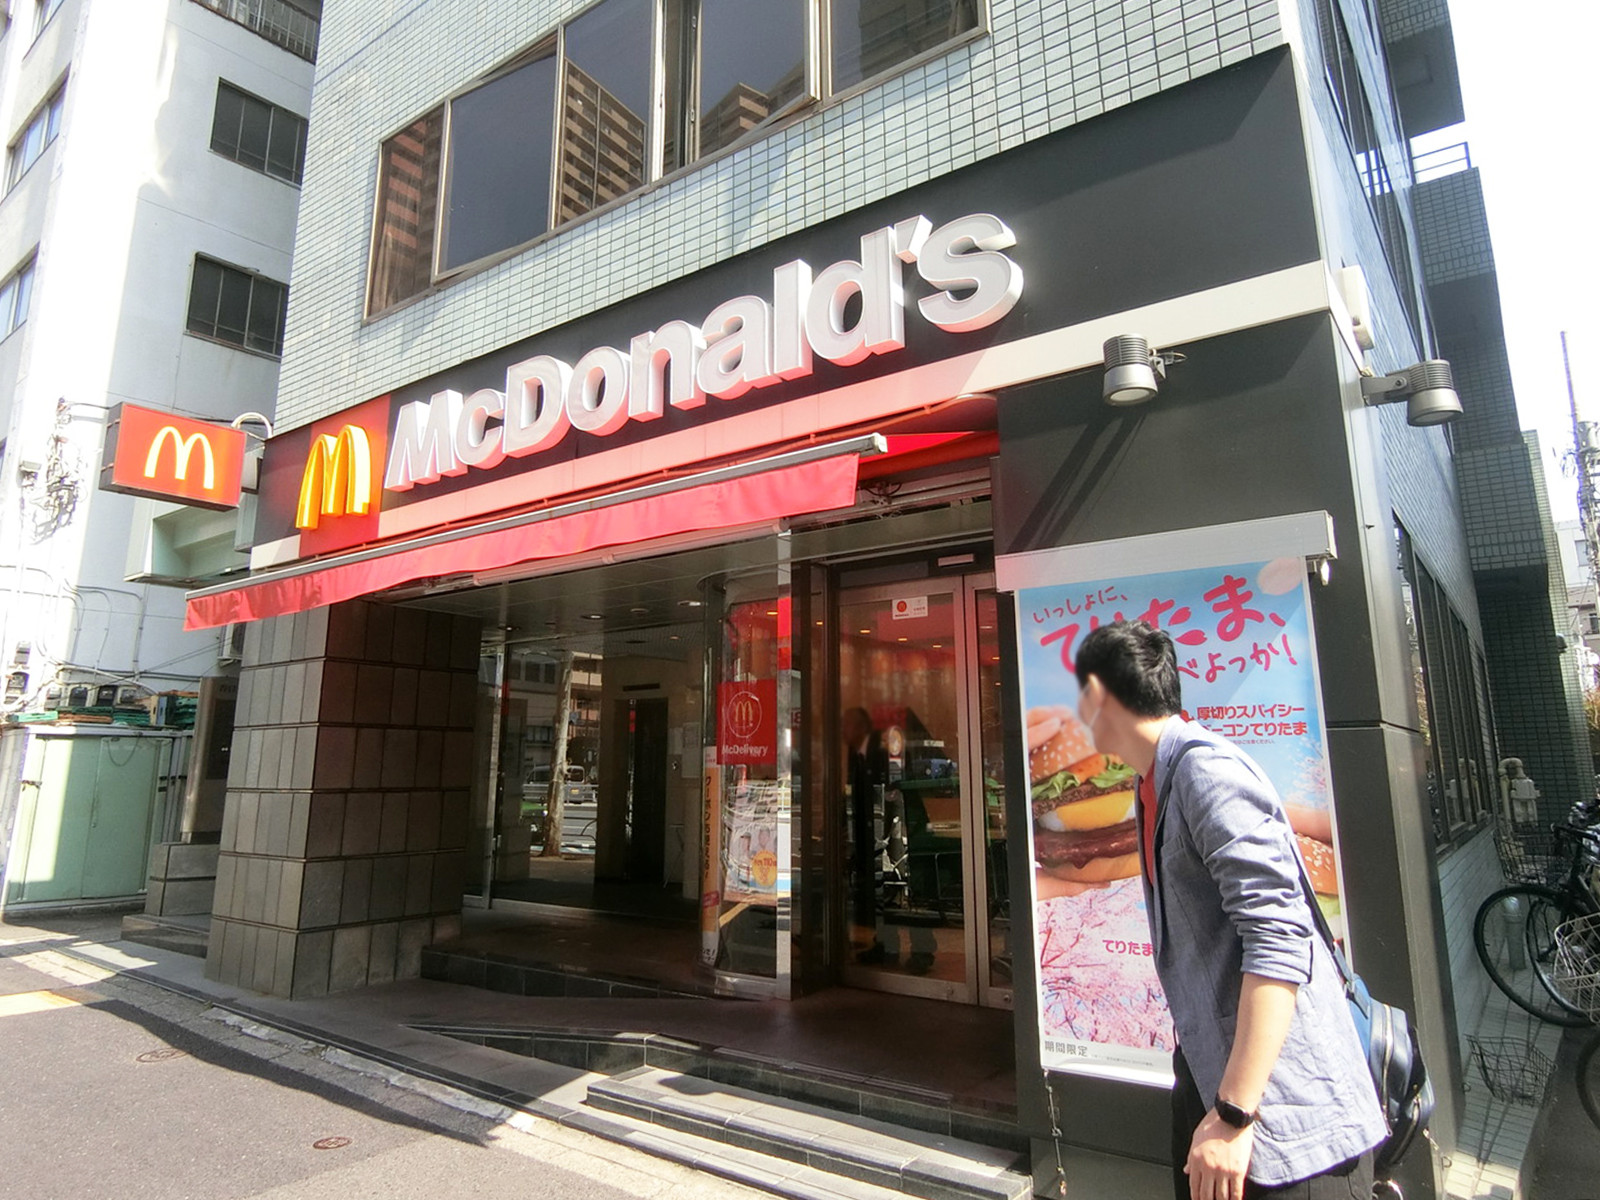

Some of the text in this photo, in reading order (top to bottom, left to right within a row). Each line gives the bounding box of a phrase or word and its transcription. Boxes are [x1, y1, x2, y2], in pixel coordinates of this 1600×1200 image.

[384, 212, 1025, 491] McDonald's
[1033, 586, 1128, 624] いっしょに、
[721, 744, 769, 757] McDelivery
[1045, 1040, 1088, 1058] 期間限定
